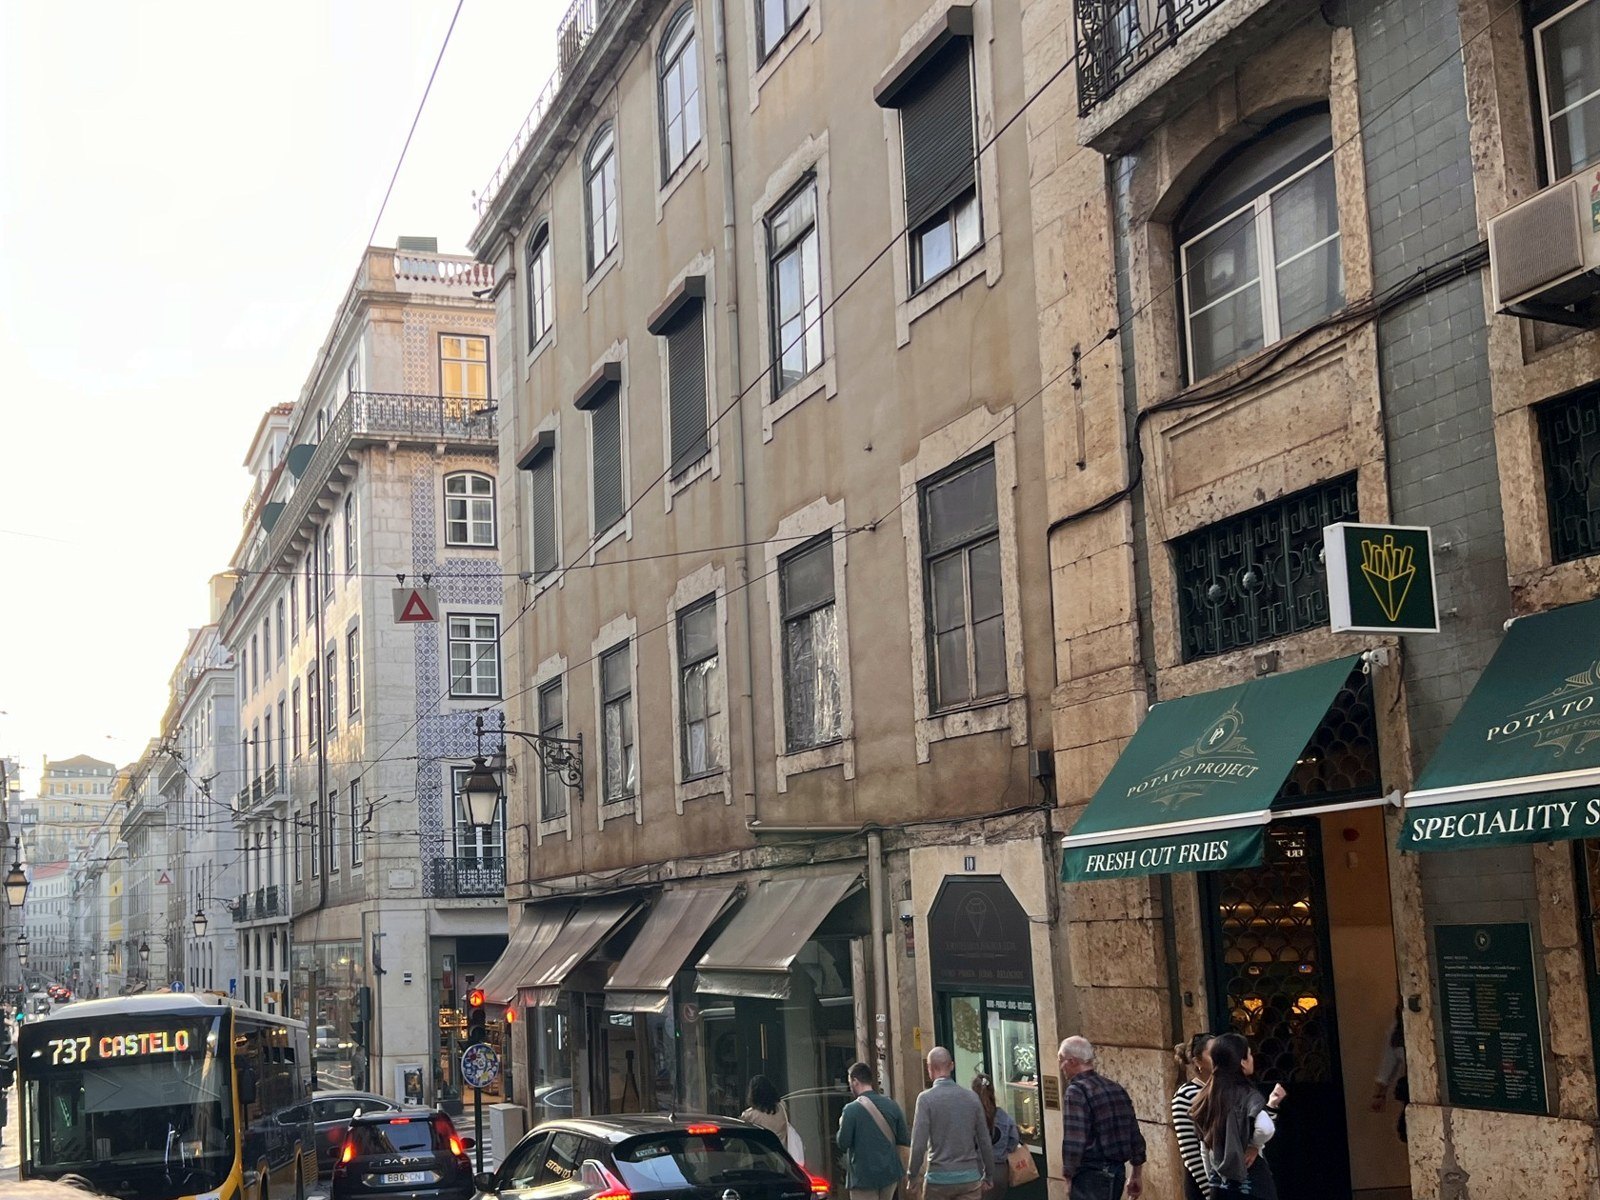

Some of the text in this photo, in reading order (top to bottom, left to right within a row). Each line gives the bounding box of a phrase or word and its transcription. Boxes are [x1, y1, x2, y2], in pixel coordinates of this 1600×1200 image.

[1486, 696, 1594, 741] POTATO
[1126, 765, 1192, 797] POTATO
[1193, 762, 1259, 778] PROJECT
[1412, 800, 1577, 841] SPECIALITY
[1085, 840, 1229, 873] FRESH CUT FRIES
[48, 1030, 189, 1065] 737 CASTELO
[384, 1157, 419, 1165] DACIA
